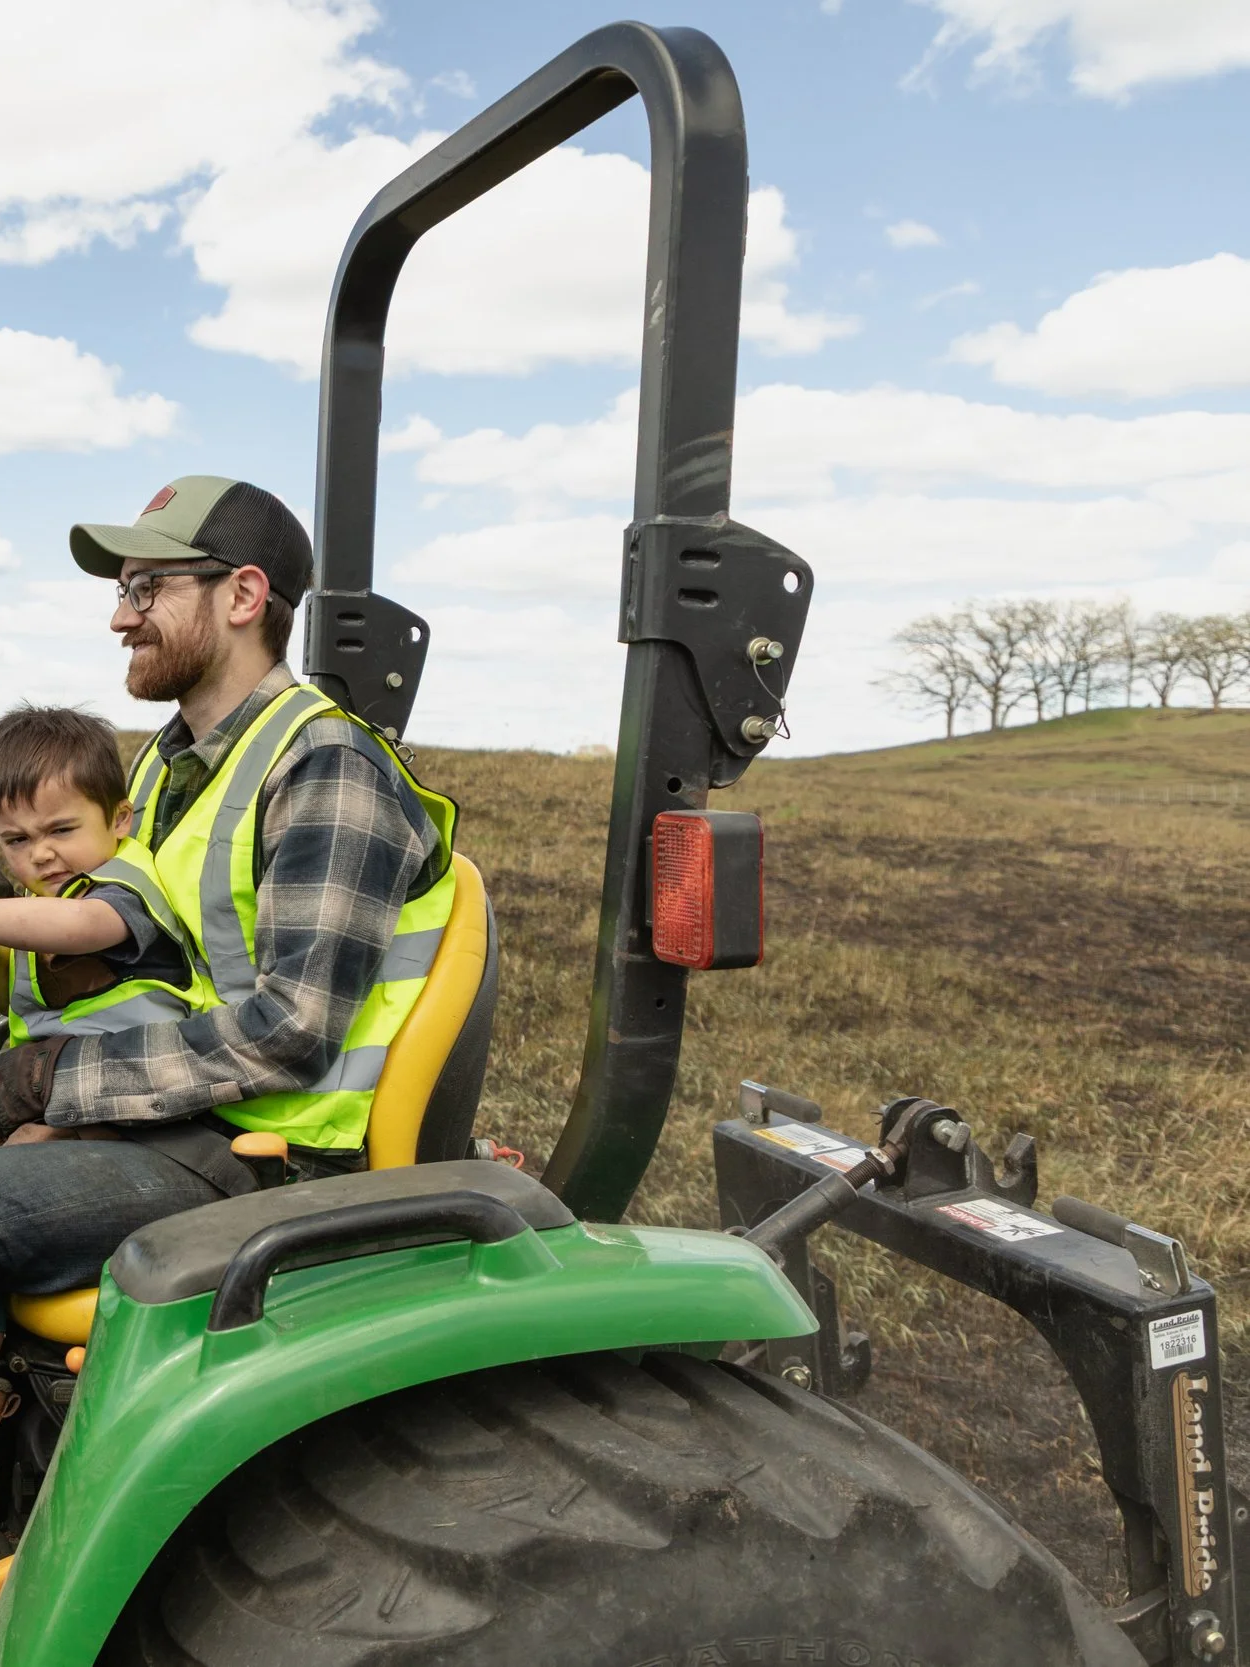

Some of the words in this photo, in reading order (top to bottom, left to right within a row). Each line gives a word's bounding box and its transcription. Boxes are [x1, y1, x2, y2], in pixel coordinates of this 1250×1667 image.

[1152, 1319, 1176, 1331] Land
[1176, 1314, 1200, 1324] Pride
[1160, 1335, 1197, 1350] 1822316
[1183, 1375, 1212, 1475] Land
[1188, 1486, 1218, 1591] Pride
